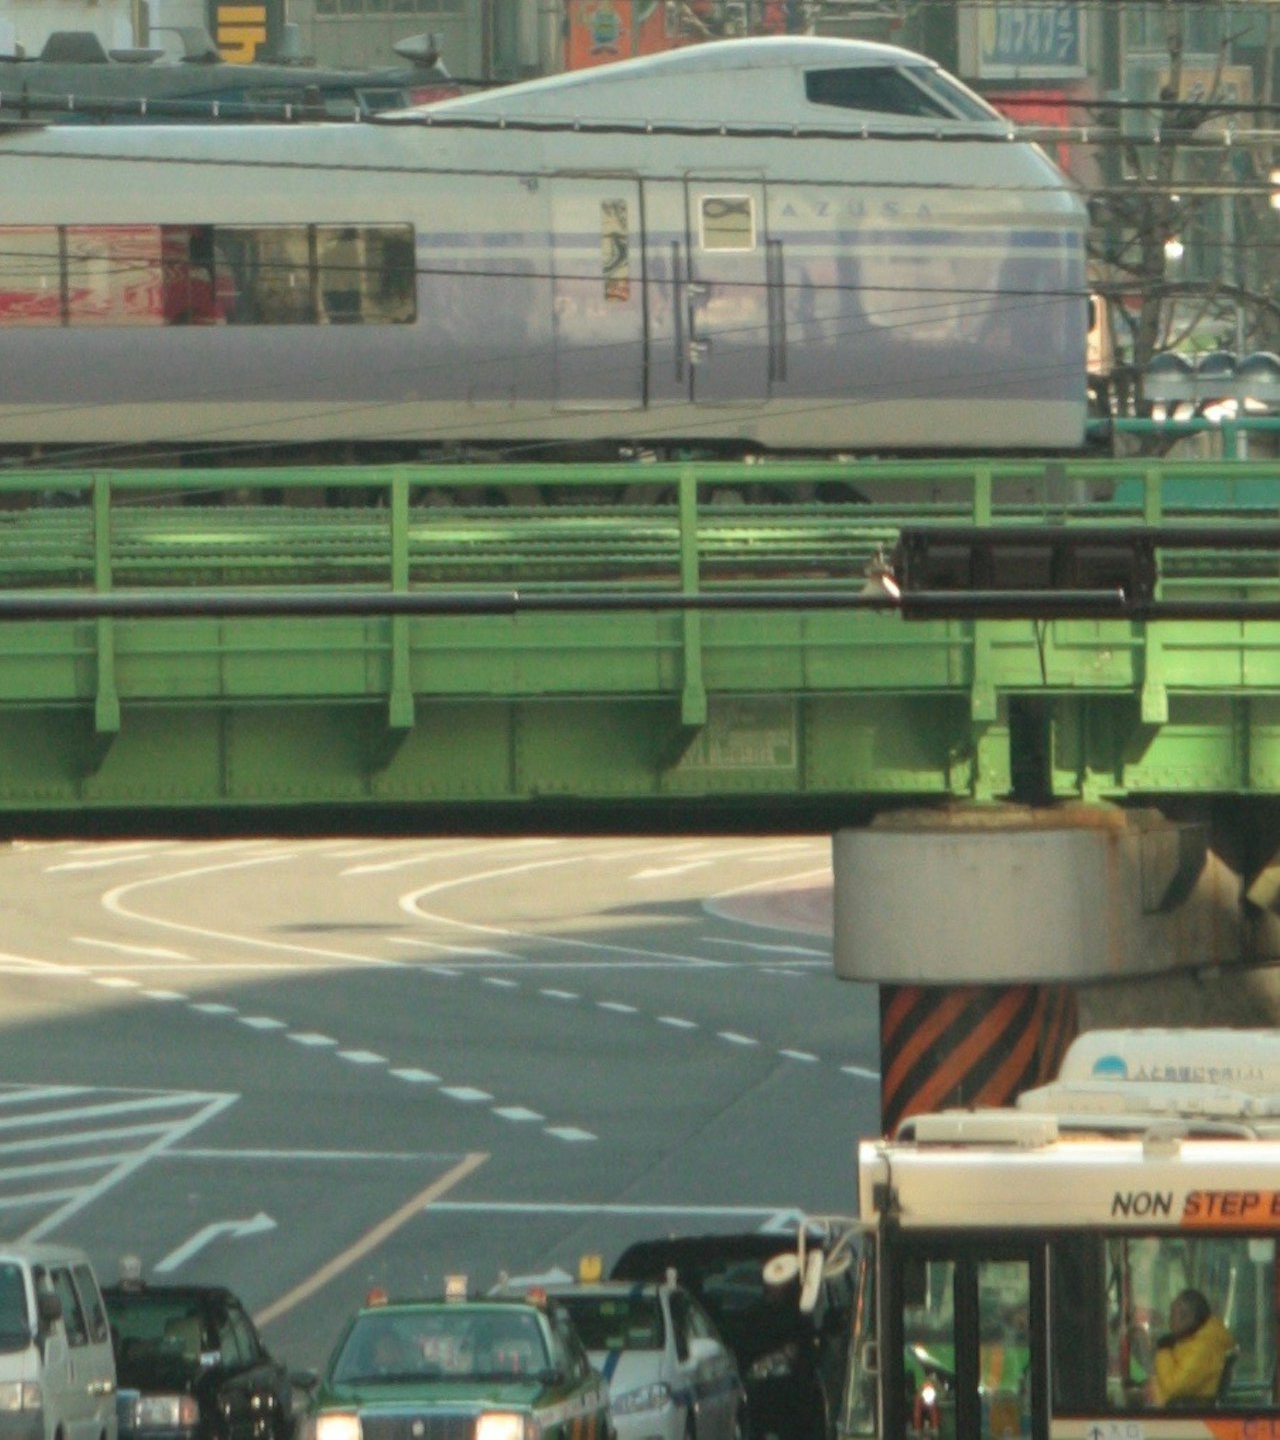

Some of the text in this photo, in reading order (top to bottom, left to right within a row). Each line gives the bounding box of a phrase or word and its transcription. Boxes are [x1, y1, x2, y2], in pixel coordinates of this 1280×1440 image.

[782, 201, 931, 218] AZUSA
[1112, 1190, 1261, 1218] NON STEP
